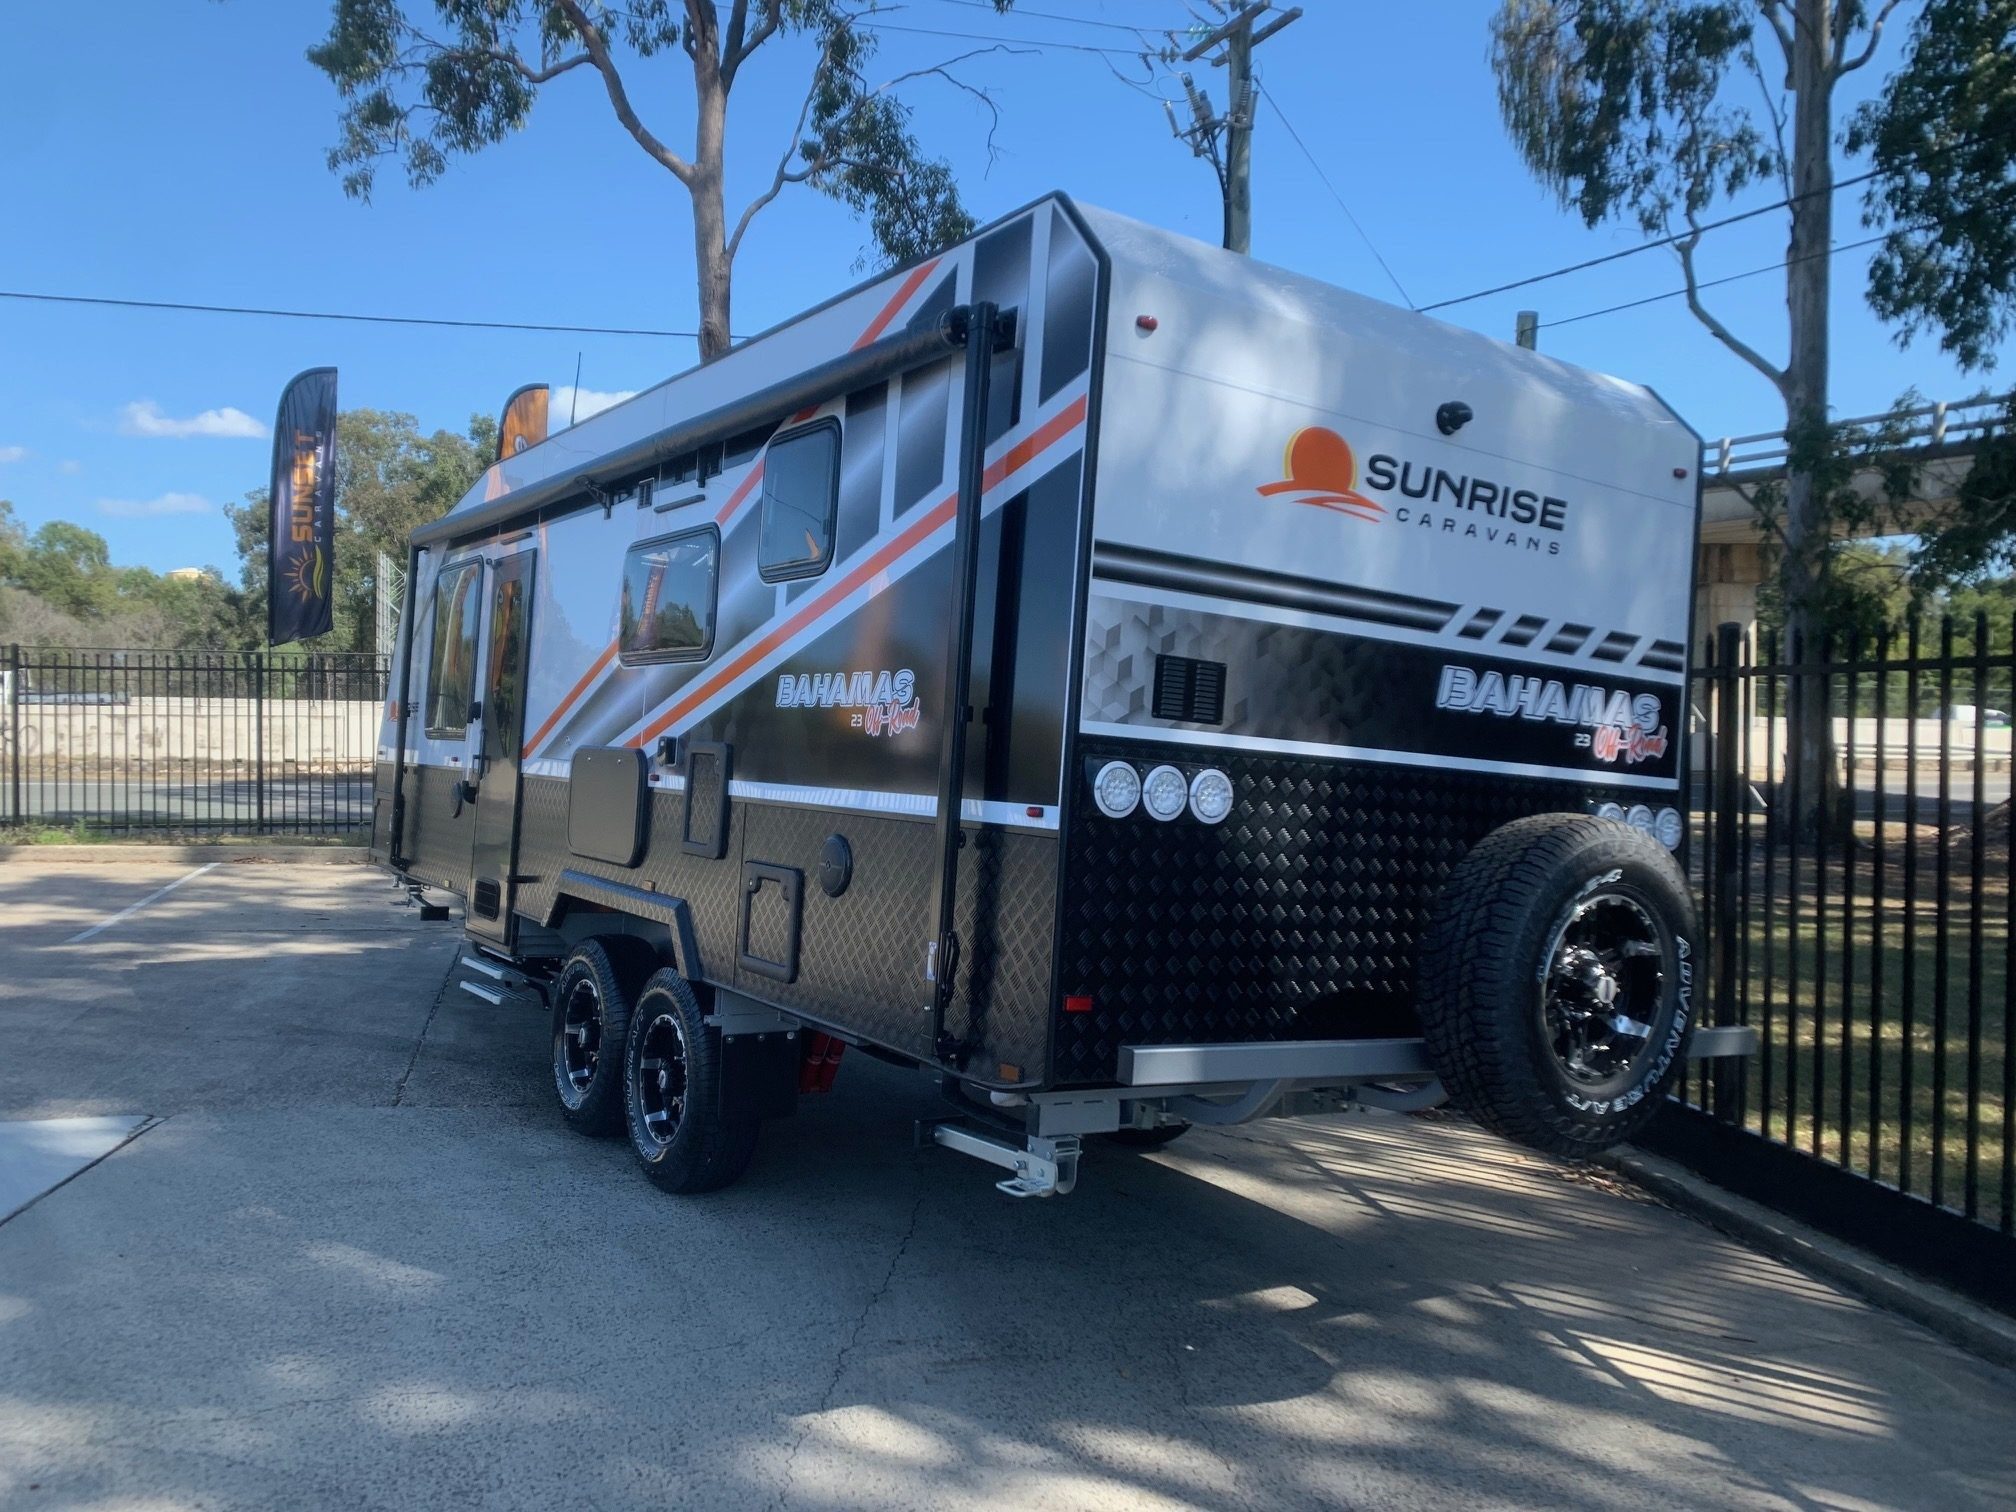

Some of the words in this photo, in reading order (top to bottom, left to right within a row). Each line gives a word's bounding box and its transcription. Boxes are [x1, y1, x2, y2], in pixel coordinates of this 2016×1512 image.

[290, 429, 315, 543] SUNSET
[1365, 453, 1568, 531] SUNRISE
[1396, 507, 1561, 555] CARAVANS
[775, 668, 916, 708] BAHAMAS
[1435, 664, 1662, 734] BAHAMAS
[850, 713, 863, 728] 23
[1574, 732, 1592, 748] 23
